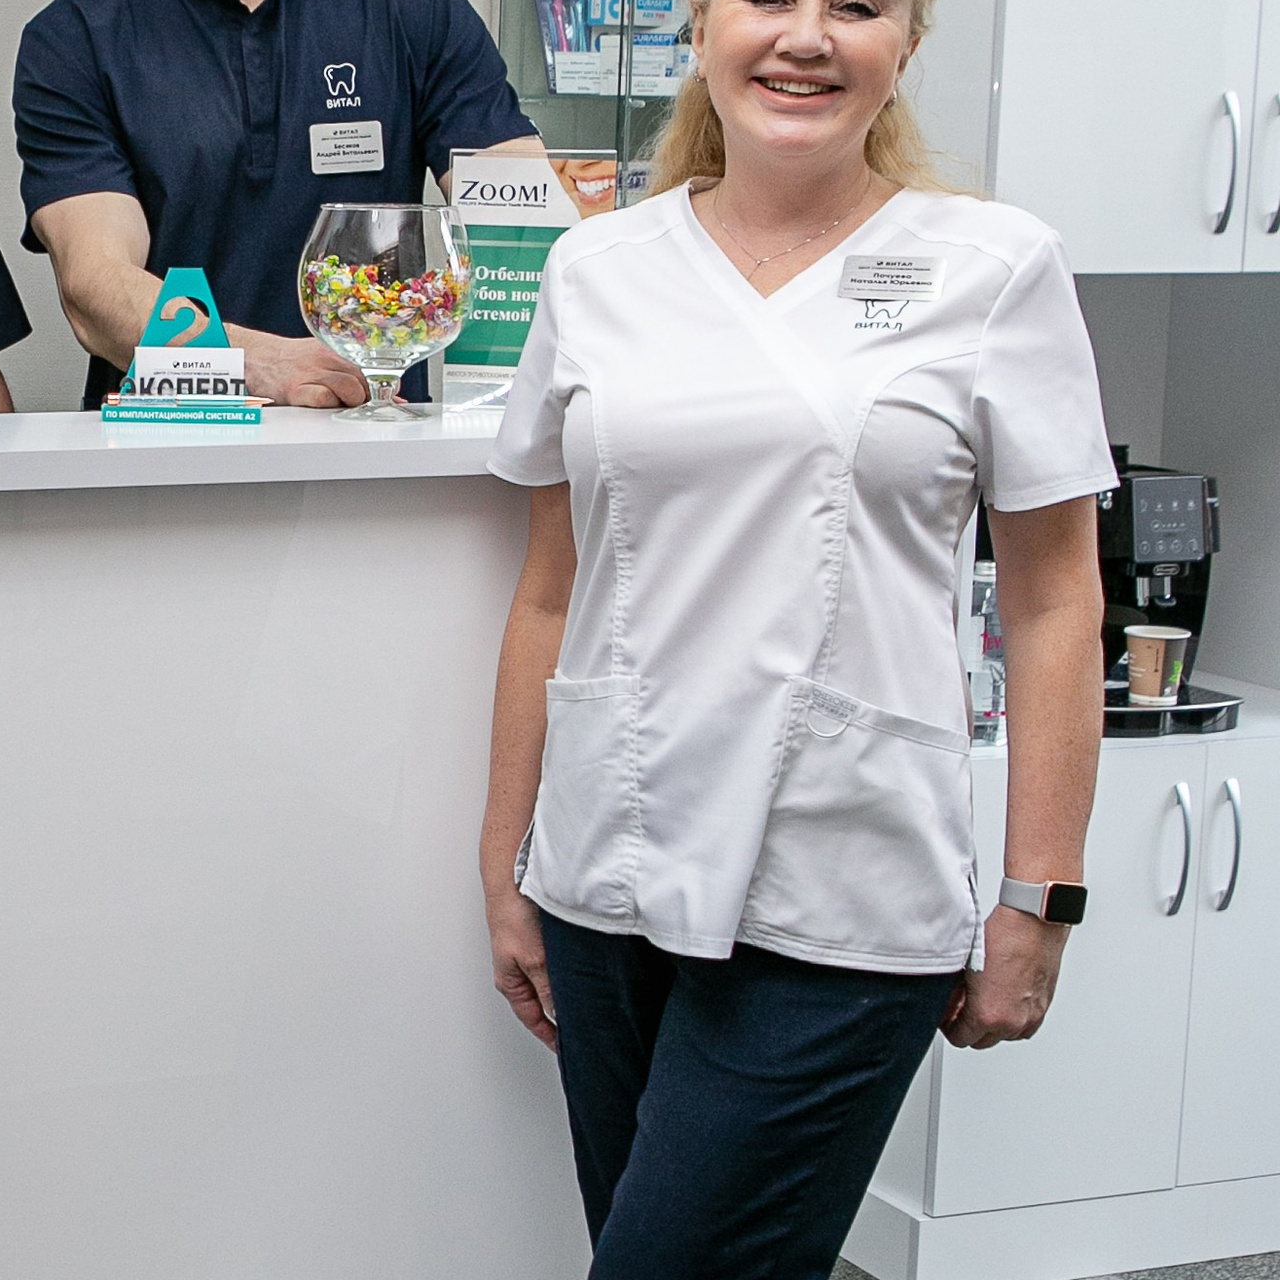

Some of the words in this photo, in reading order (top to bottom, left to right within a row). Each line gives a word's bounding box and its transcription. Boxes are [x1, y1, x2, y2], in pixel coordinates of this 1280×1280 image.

[326, 97, 361, 109] ВИТАЛ
[459, 180, 547, 202] ZOOM!
[854, 322, 903, 332] ВИТАЛ
[106, 411, 117, 419] ПО
[118, 410, 204, 421] ИМПЛАНТАЦИОННОЙ
[206, 412, 243, 421] СИСТЕМЕ
